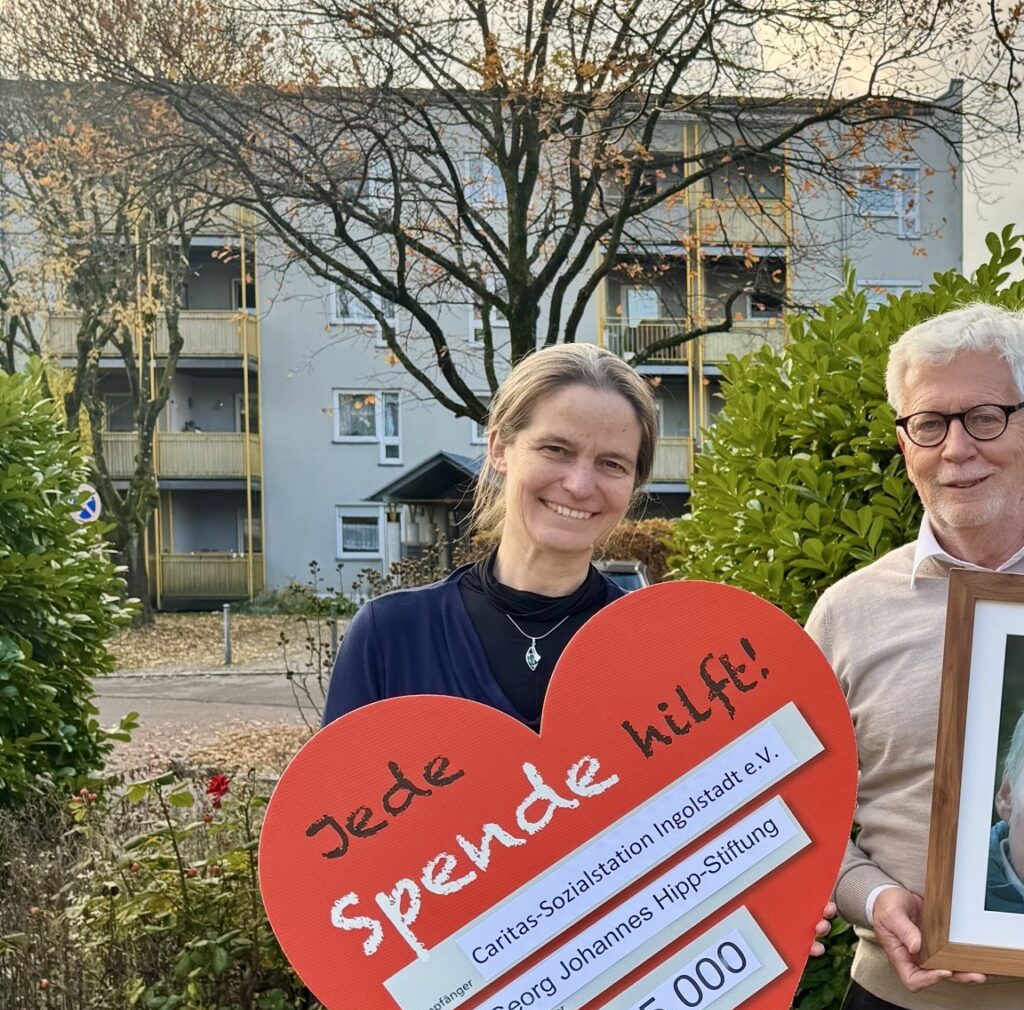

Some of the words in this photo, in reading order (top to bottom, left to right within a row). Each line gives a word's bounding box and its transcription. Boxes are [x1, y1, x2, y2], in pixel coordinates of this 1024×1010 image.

[305, 754, 466, 859] Jede
[330, 754, 620, 961] Spende
[621, 637, 770, 759] hilft!
[472, 833, 655, 964] Caritas-Sozialstation
[653, 770, 743, 838] Ingolstadt
[744, 746, 779, 775] e.V.
[559, 906, 654, 981] Johannes
[652, 818, 780, 911] Hipp-Stiftung
